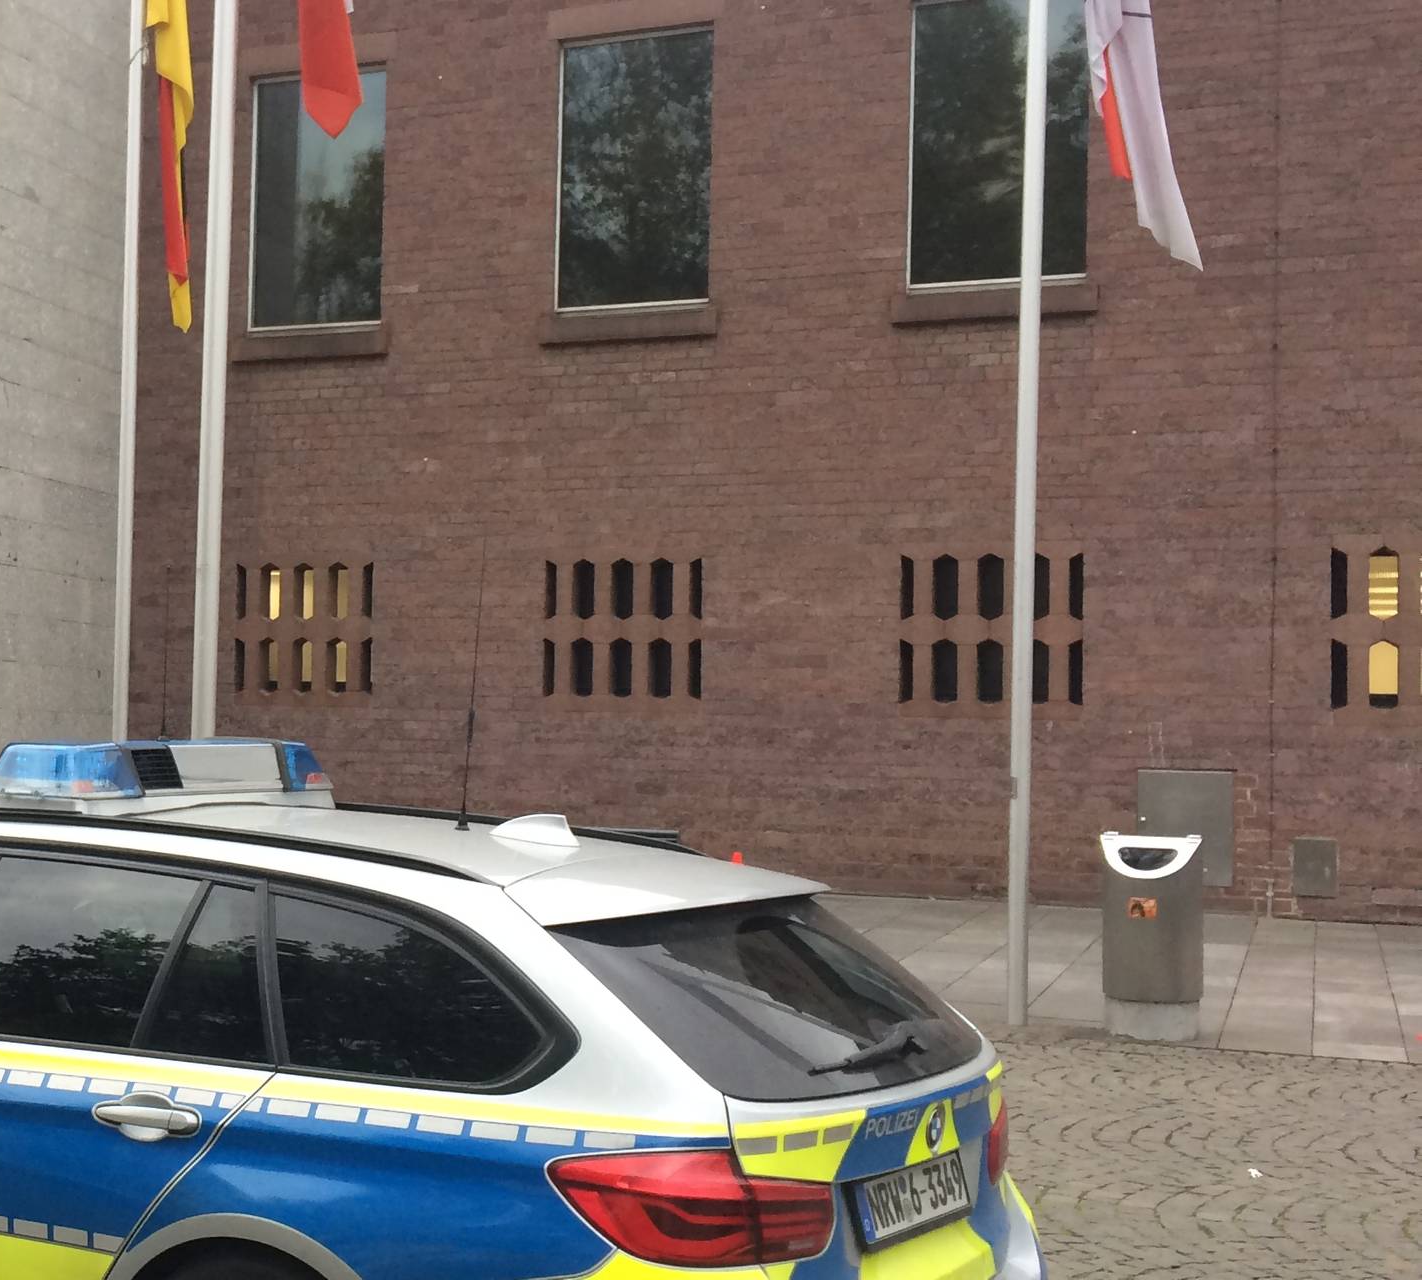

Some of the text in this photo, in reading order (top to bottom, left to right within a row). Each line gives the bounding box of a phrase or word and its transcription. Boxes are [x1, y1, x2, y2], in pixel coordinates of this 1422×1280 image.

[865, 1108, 919, 1139] POLIZEI
[866, 1158, 963, 1231] NRW 6-3349
